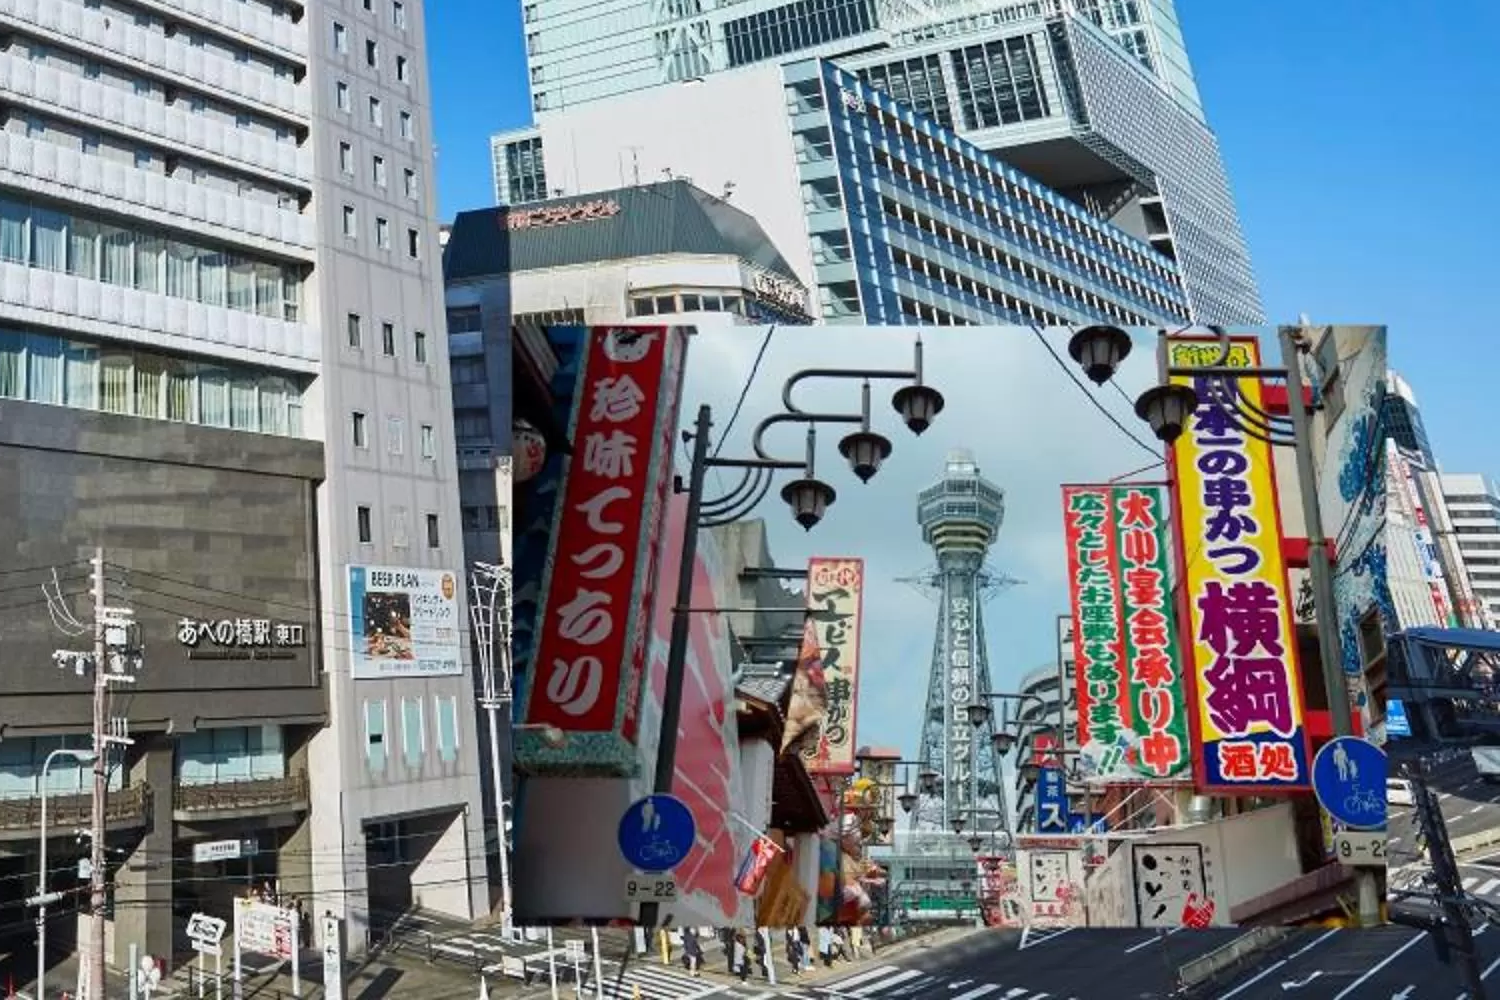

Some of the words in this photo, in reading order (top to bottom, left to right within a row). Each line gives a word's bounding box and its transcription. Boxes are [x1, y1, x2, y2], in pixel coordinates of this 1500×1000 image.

[371, 571, 393, 587] BEER
[395, 573, 420, 588] PLAN
[178, 617, 271, 646] あべの橋駅
[274, 623, 304, 646] 東口
[1197, 580, 1294, 735] 横綱
[1220, 742, 1297, 780] 酒処
